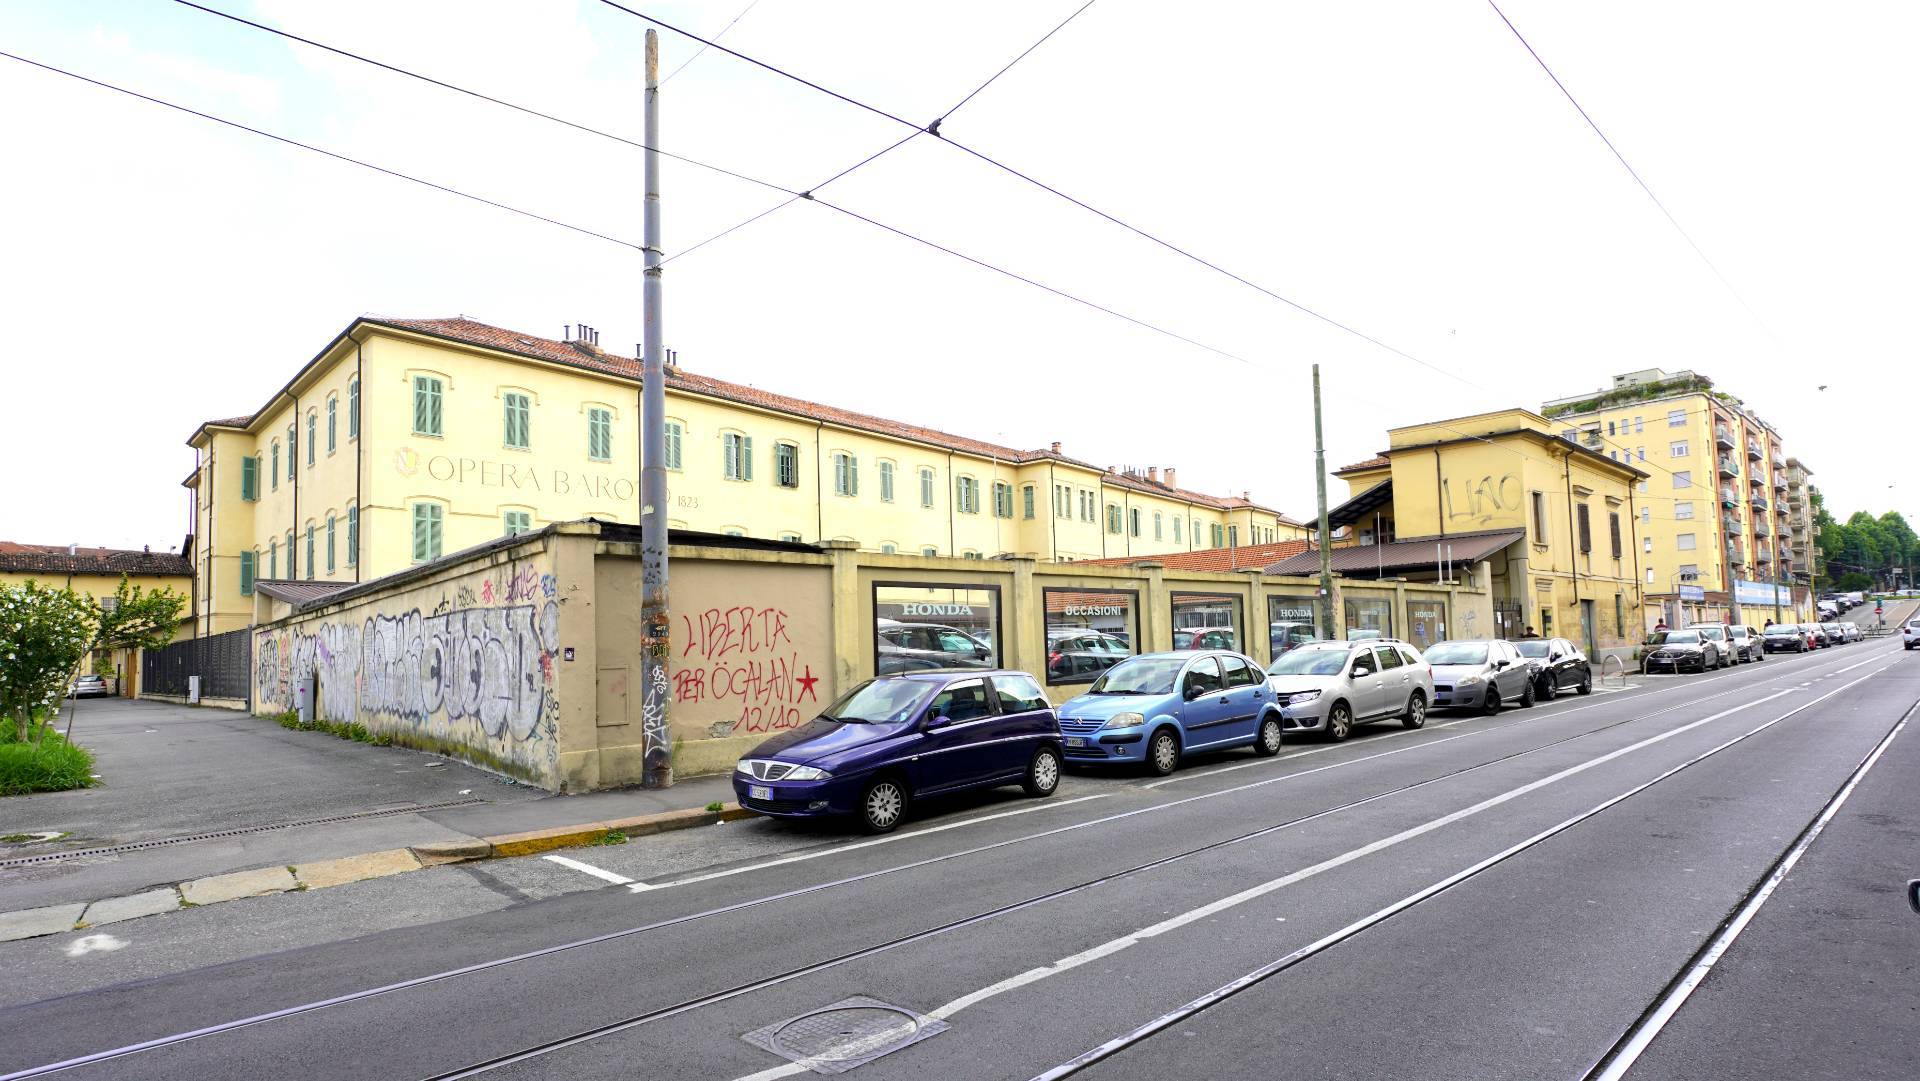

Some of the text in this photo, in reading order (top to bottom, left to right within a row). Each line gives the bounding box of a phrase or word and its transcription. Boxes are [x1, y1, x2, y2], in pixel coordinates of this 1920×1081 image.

[428, 455, 699, 509] OPERA BARO 1823
[902, 604, 974, 616] HONDA
[1065, 605, 1121, 616] OCCASIONI
[1280, 609, 1313, 617] HONDA
[1414, 610, 1436, 618] HONDA
[683, 606, 791, 660] LIBERTÀ
[673, 668, 705, 703] PER
[732, 705, 800, 733] 12/10
